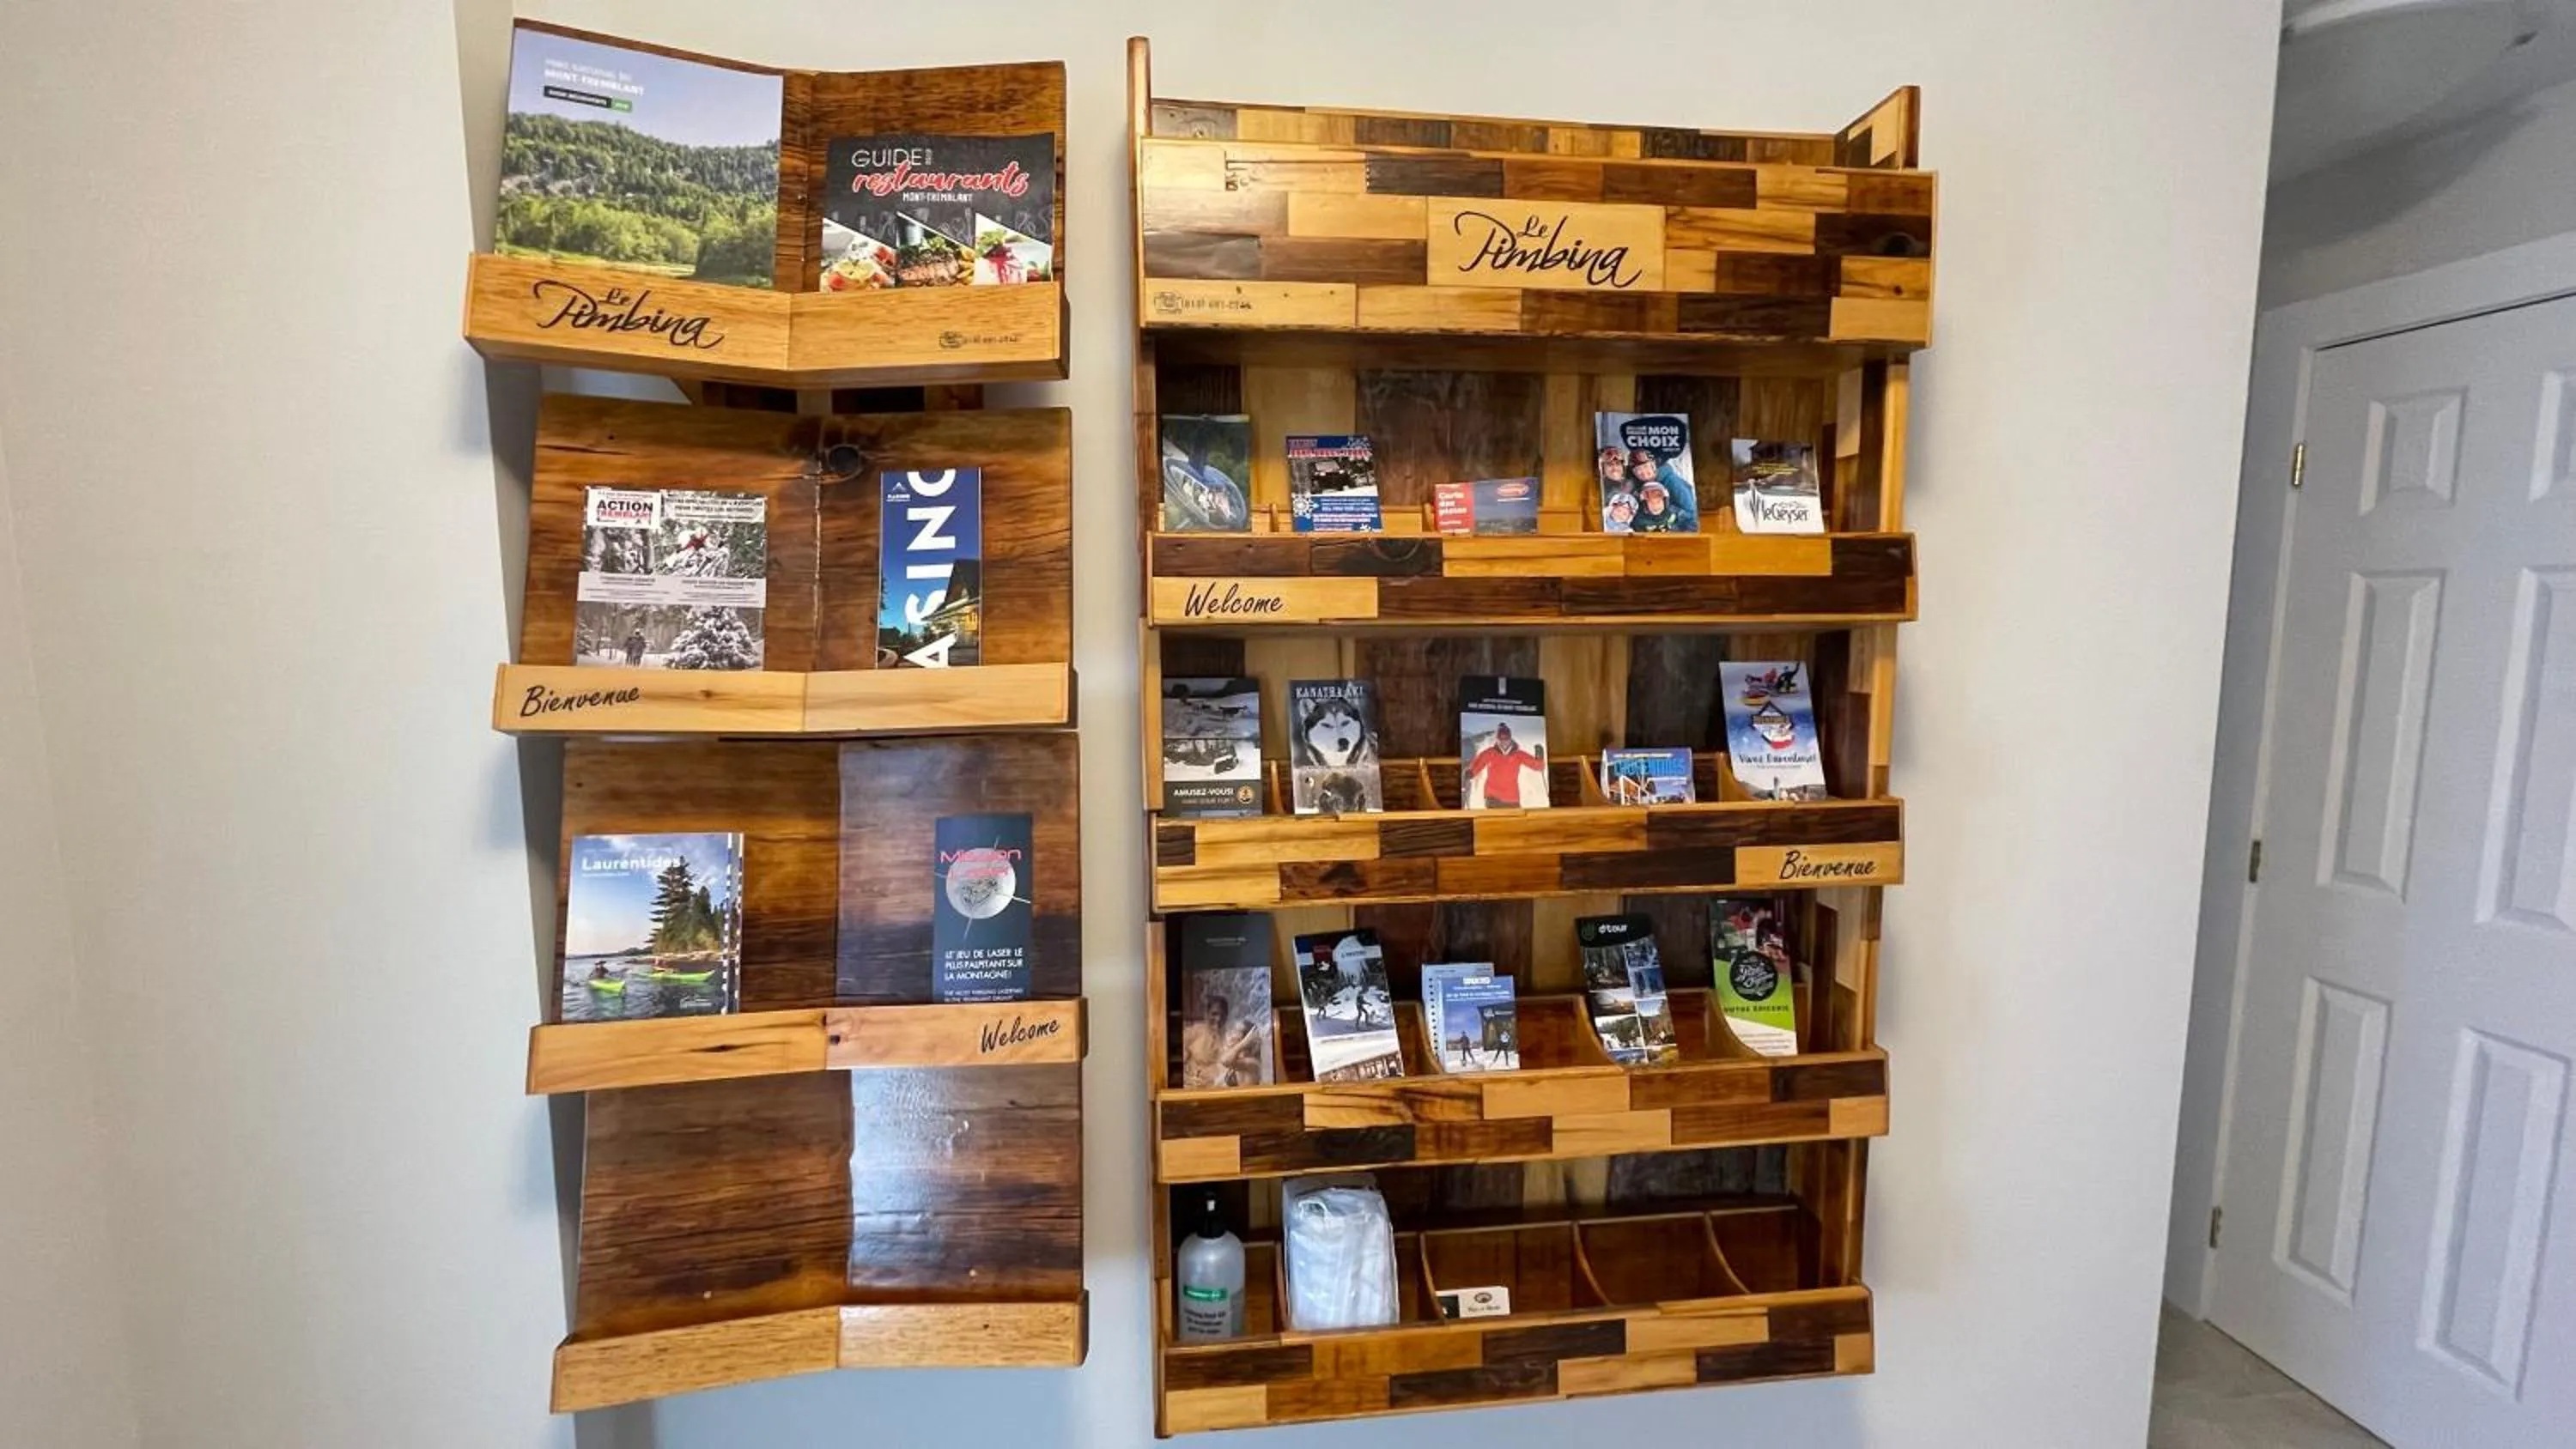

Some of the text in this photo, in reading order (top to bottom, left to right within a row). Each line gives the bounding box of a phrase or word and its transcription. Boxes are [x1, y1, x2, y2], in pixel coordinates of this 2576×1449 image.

[851, 149, 921, 167] GUIDE
[852, 161, 1030, 196] restaurants
[1649, 426, 1679, 435] MON
[1626, 436, 1680, 447] CHOIX
[597, 500, 653, 512] ACTION
[1185, 582, 1284, 616] Welcome
[520, 685, 640, 718] Bienvenue
[581, 857, 681, 870] Laurentides
[1779, 850, 1875, 880] Bienvenue
[987, 948, 1012, 957] LASER
[981, 1016, 1060, 1053] Welcome
